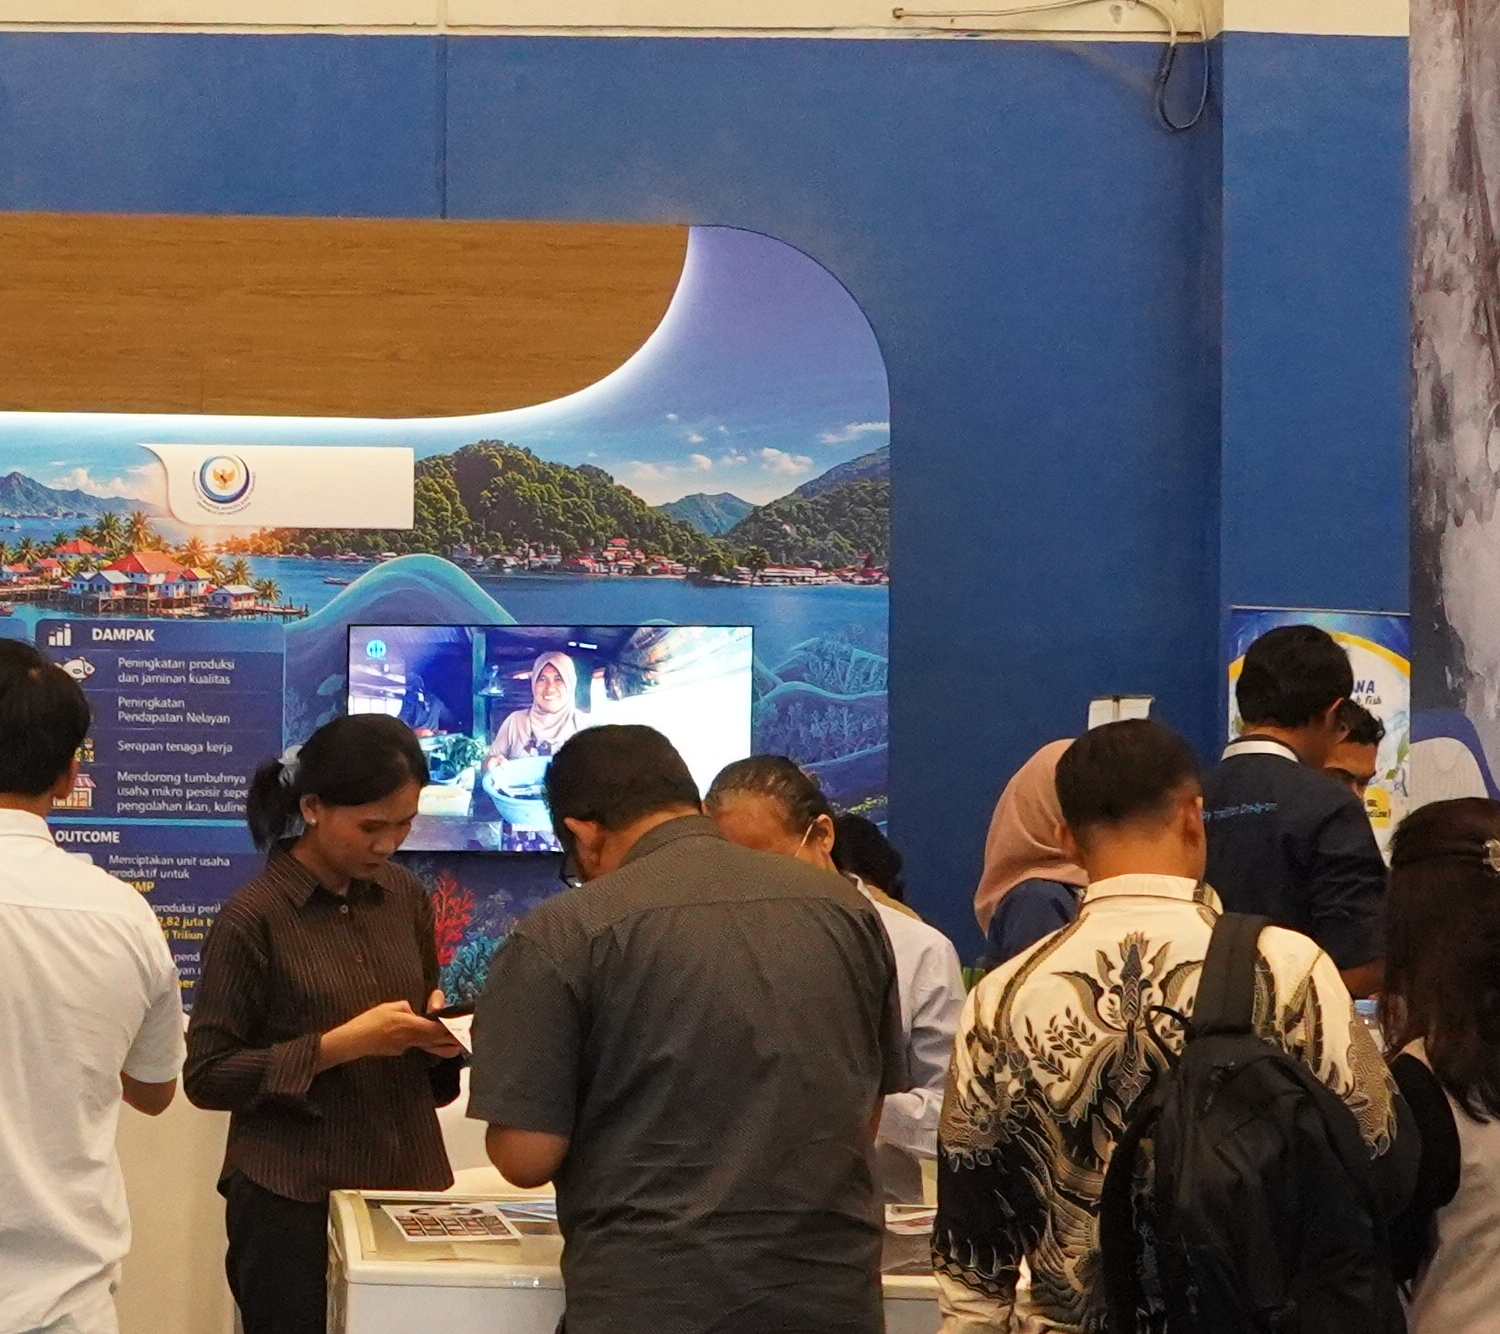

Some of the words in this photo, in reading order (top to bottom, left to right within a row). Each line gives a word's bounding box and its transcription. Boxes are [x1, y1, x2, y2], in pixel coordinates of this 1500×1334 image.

[92, 628, 155, 642] DAMPAK
[117, 657, 186, 670] Peningkatan
[189, 658, 235, 671] produksi
[117, 673, 140, 683] dan
[141, 673, 186, 685] jaminan
[189, 674, 231, 685] kualitas
[117, 697, 185, 710] Peningkatan
[117, 712, 184, 724] Pendapatan
[186, 712, 231, 725] Nelayan
[117, 740, 163, 753] Serapan
[166, 741, 204, 754] tenaga
[206, 741, 233, 755] kerja
[117, 771, 181, 785] Mendorong
[184, 772, 246, 785] tumbuhnya
[117, 786, 149, 797] usaha
[152, 787, 183, 798] mikro
[186, 788, 221, 799] pesisir
[223, 789, 248, 800] sepe
[117, 801, 183, 814] pengolahan
[214, 802, 247, 813] kuline
[55, 830, 120, 843] OUTCOME
[177, 856, 198, 866] unit
[200, 857, 230, 867] usaha
